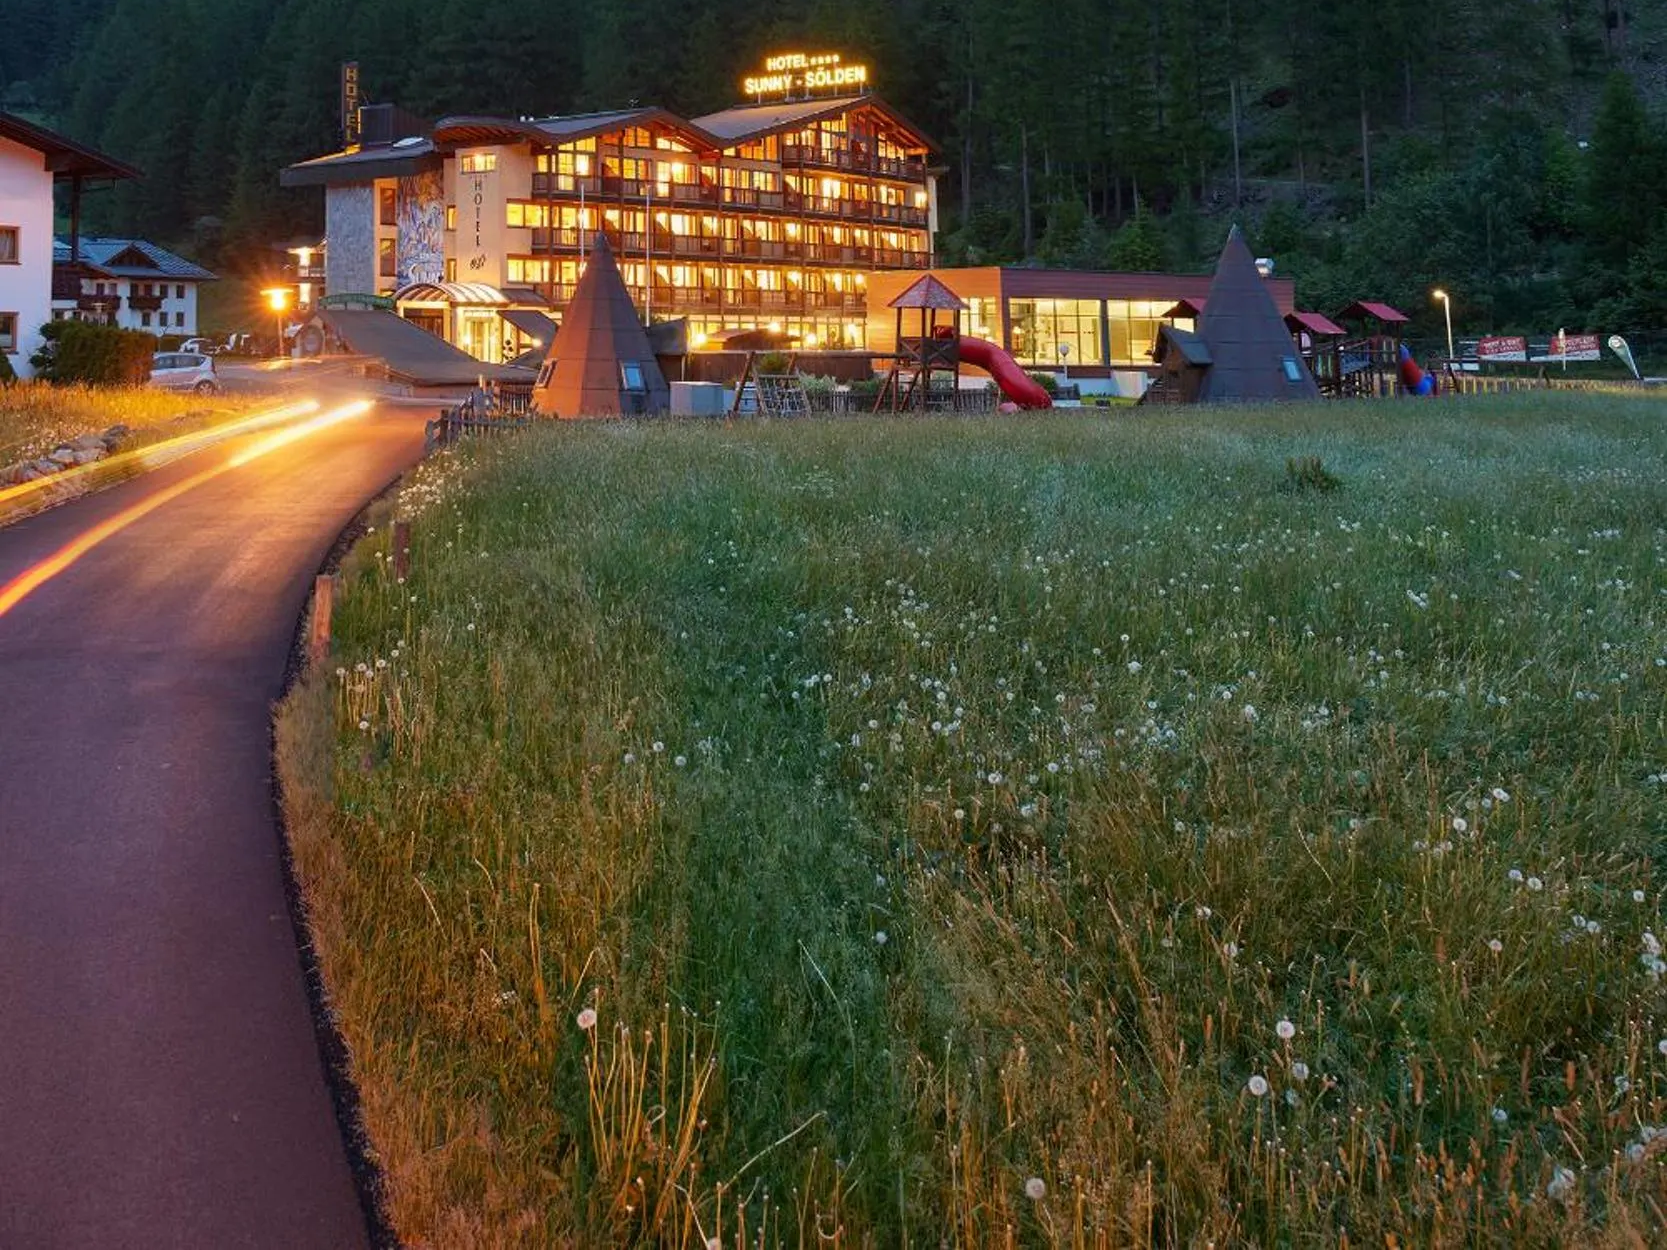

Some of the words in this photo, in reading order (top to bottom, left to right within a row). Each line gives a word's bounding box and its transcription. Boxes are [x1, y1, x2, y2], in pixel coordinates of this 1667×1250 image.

[744, 74, 792, 94] SUNNY
[805, 66, 866, 88] SÖLDEN
[766, 53, 808, 71] HOTEL
[346, 67, 358, 141] HOTEL
[474, 178, 482, 247] HOTEL
